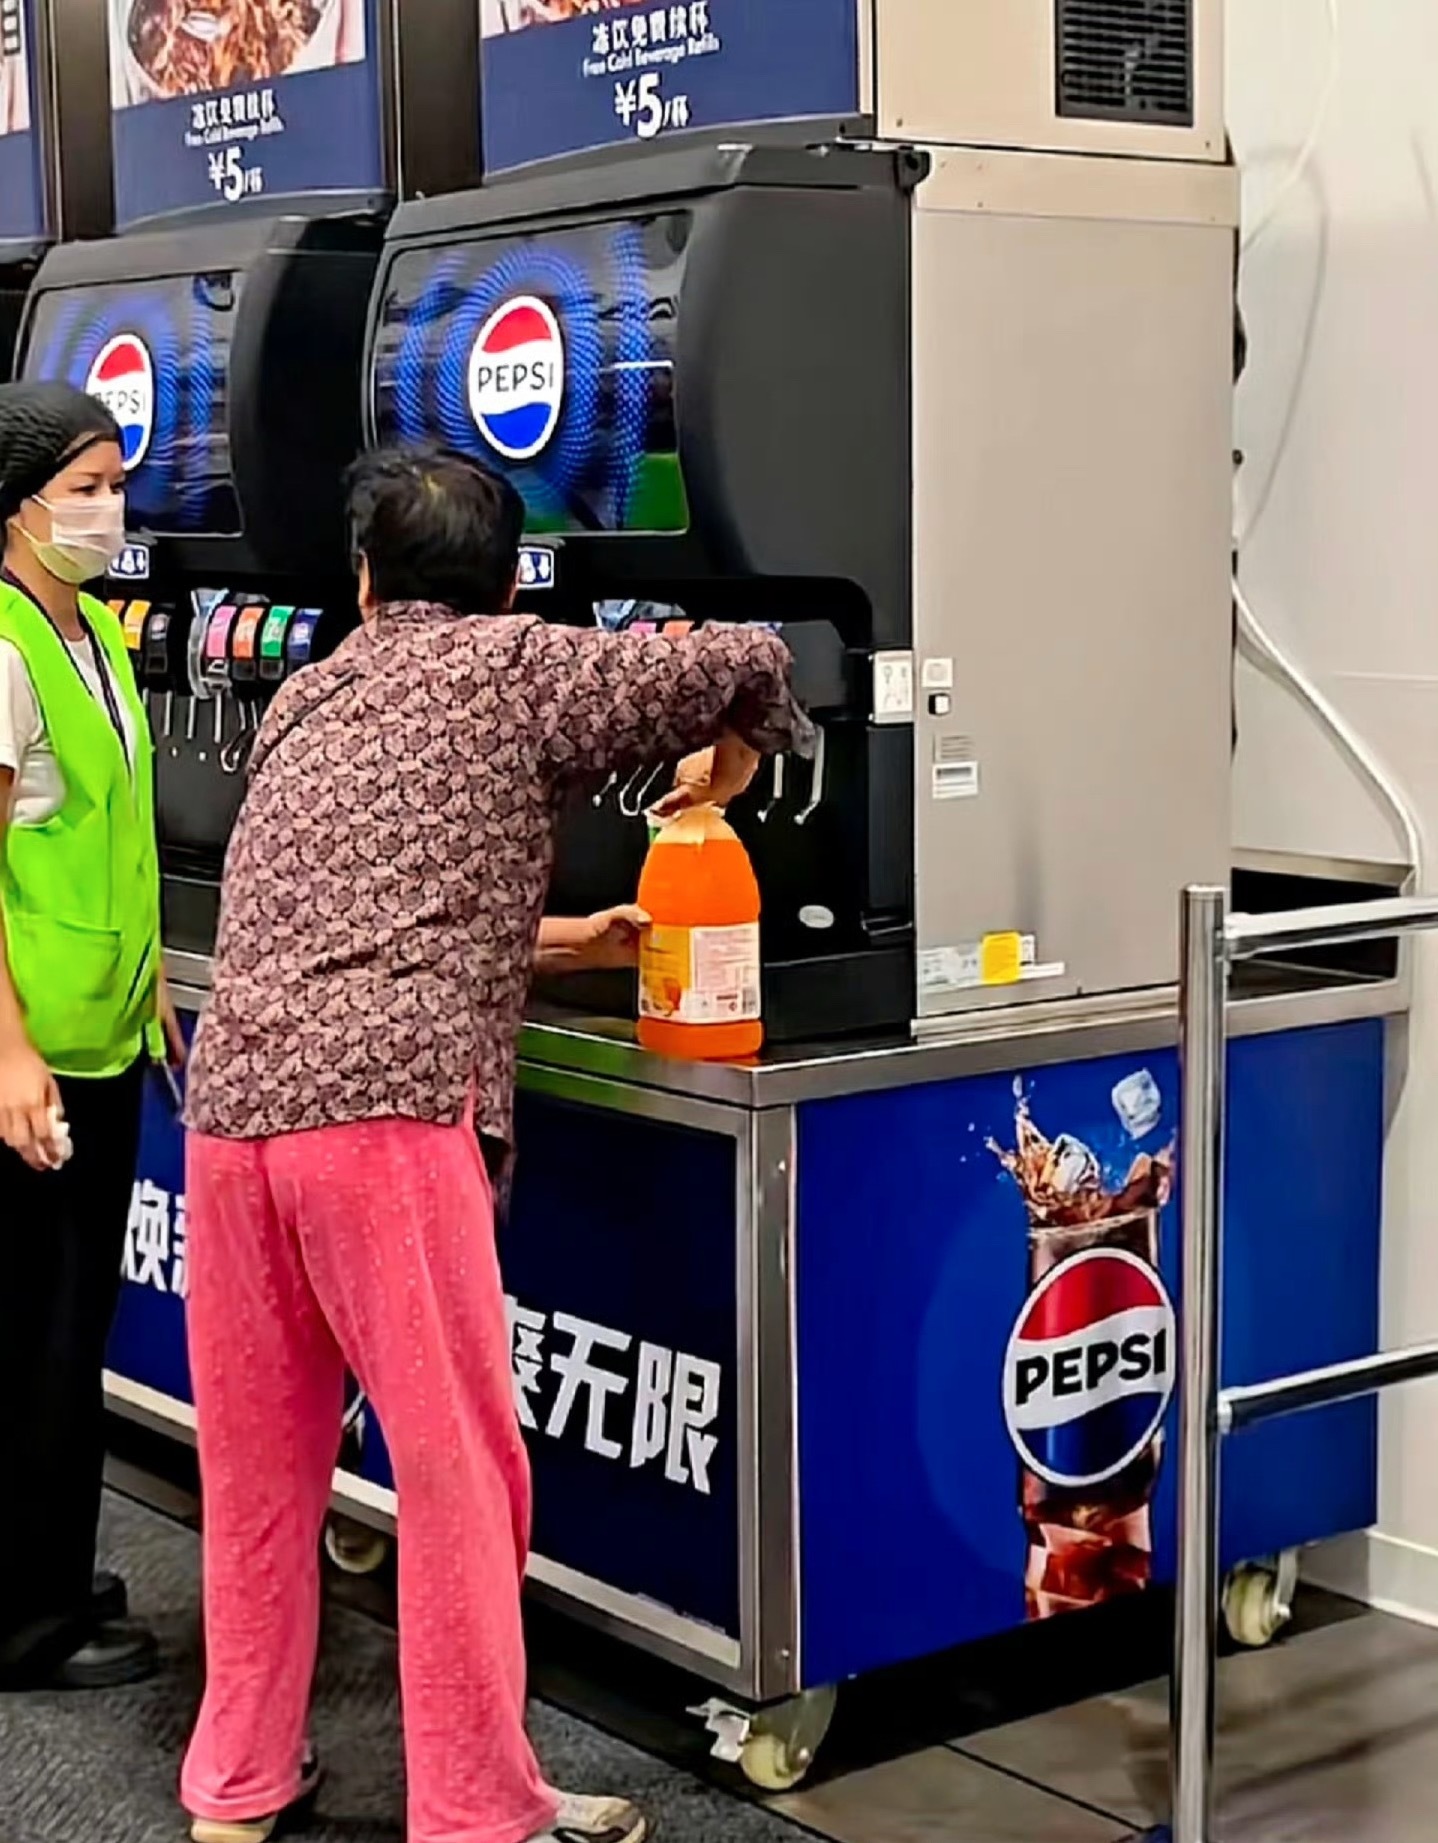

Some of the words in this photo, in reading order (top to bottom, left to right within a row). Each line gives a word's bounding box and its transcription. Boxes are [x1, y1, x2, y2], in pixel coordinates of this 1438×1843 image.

[478, 361, 554, 393] PEPSI
[120, 1178, 186, 1299] 焕
[1015, 1327, 1166, 1406] PEPSI
